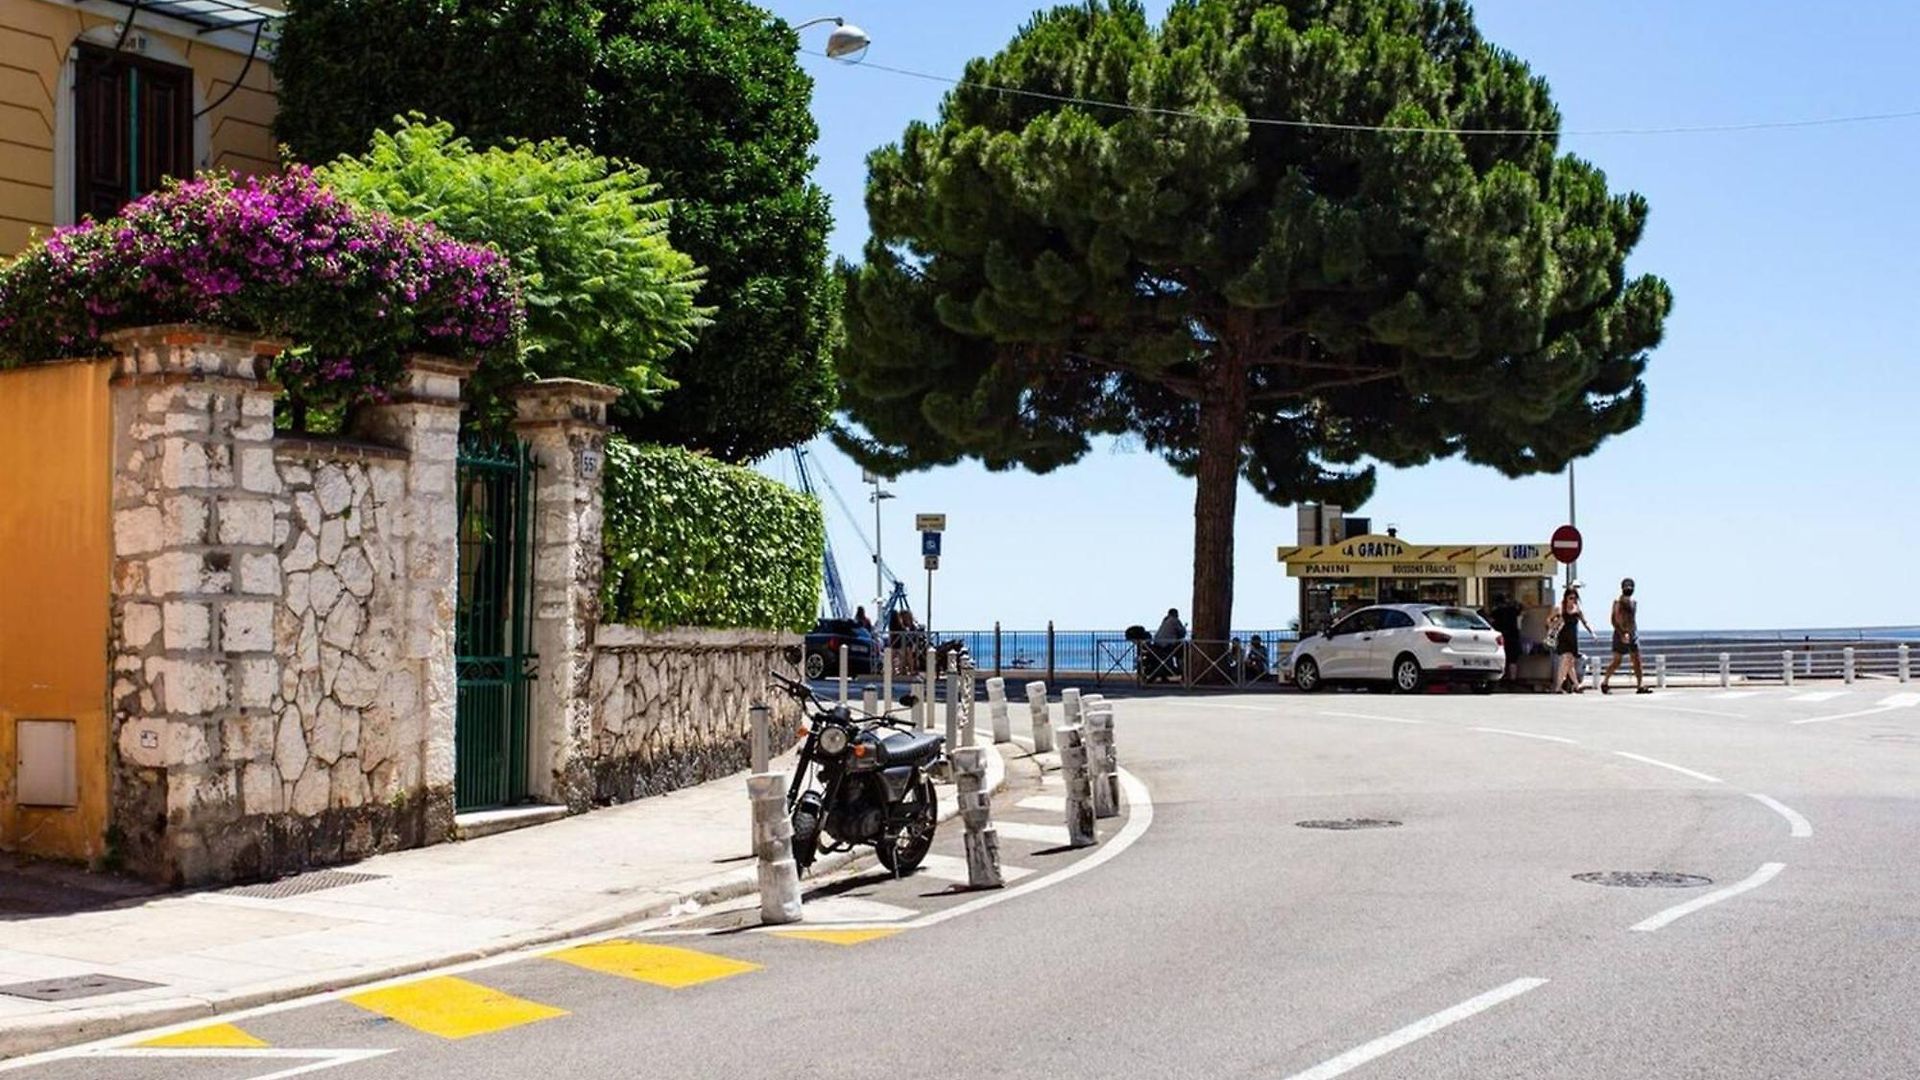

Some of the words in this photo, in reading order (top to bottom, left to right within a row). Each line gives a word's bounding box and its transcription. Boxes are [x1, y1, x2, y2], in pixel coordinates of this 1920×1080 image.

[1342, 544, 1354, 557] LA
[1358, 542, 1403, 557] GRATTA
[1512, 544, 1539, 559] GRATTA
[1305, 564, 1350, 573] PANINI
[1488, 563, 1507, 573] PAN
[1509, 563, 1543, 573] BAGNAT
